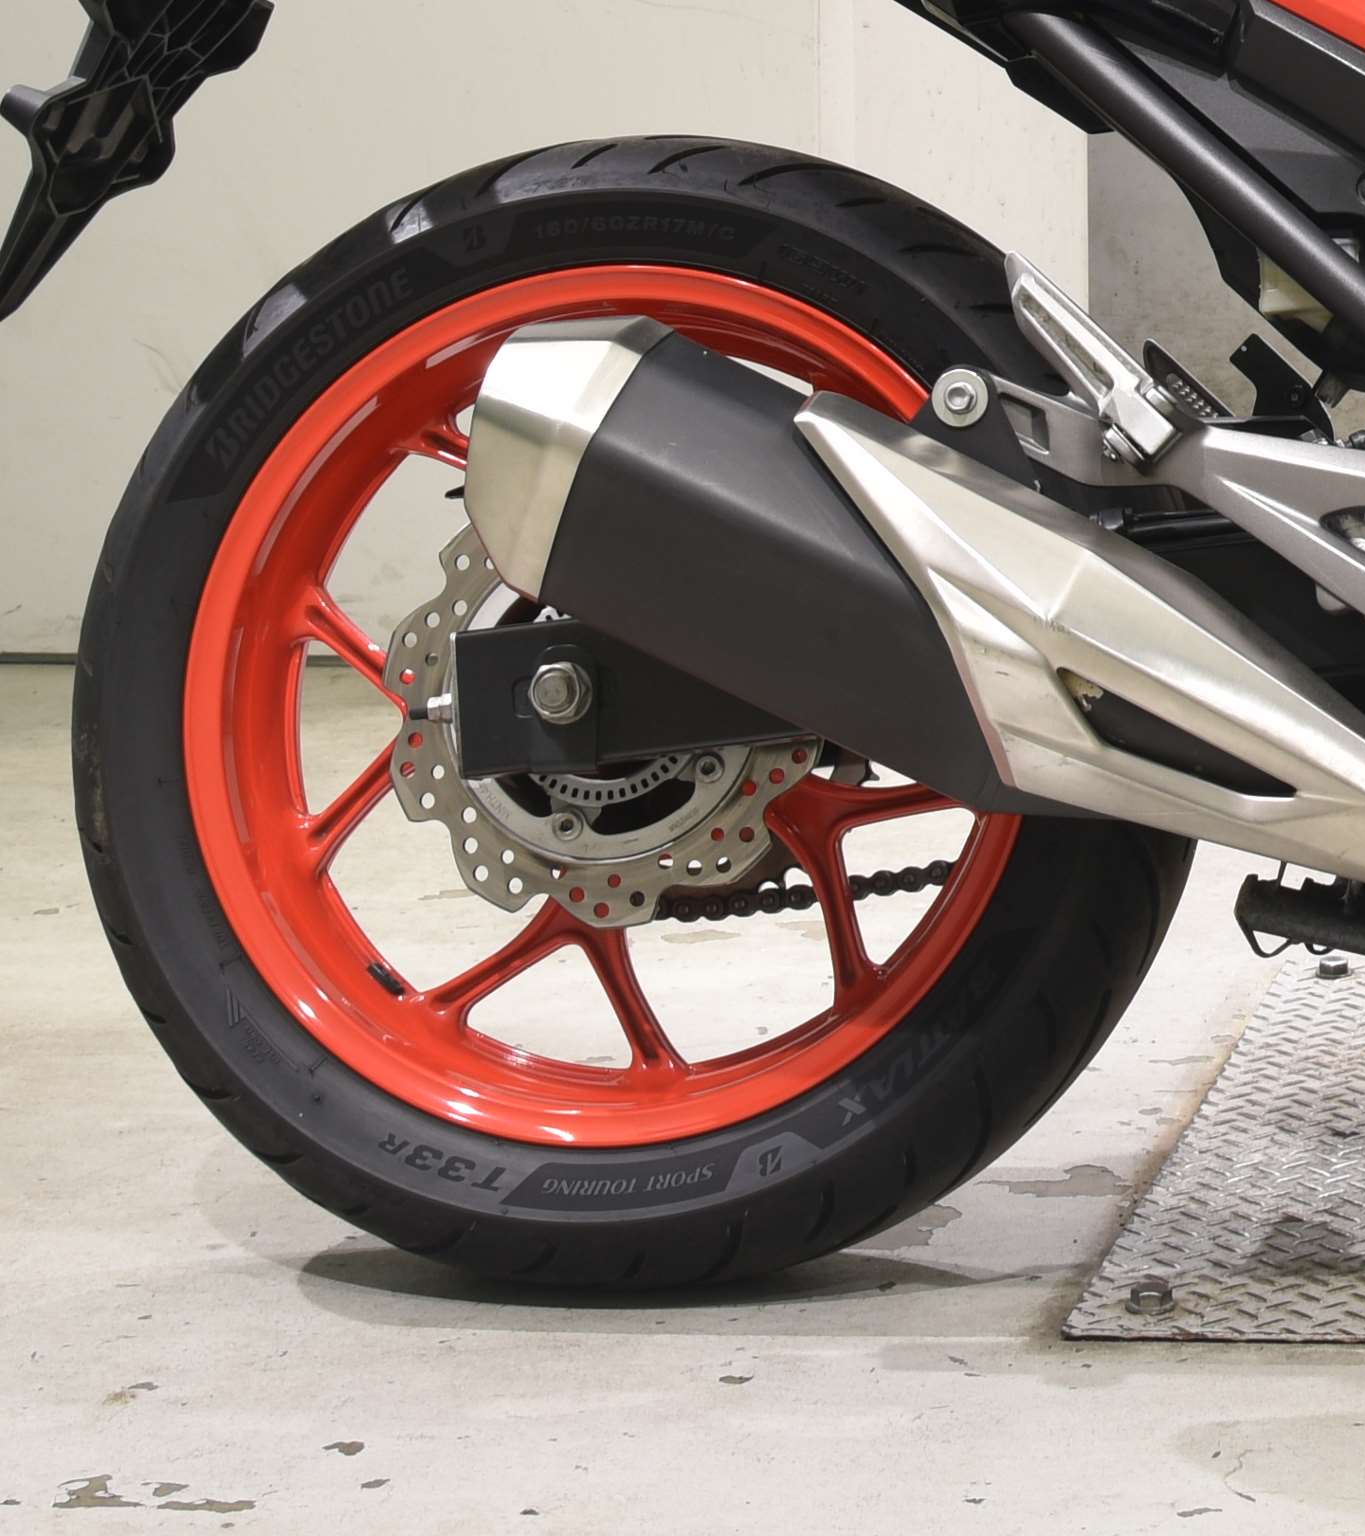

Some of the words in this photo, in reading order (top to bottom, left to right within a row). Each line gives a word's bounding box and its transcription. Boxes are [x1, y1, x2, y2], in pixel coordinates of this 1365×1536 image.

[375, 1130, 509, 1193] T33R
[642, 1161, 716, 1193] SPORT
[537, 1175, 639, 1197] TOURING
